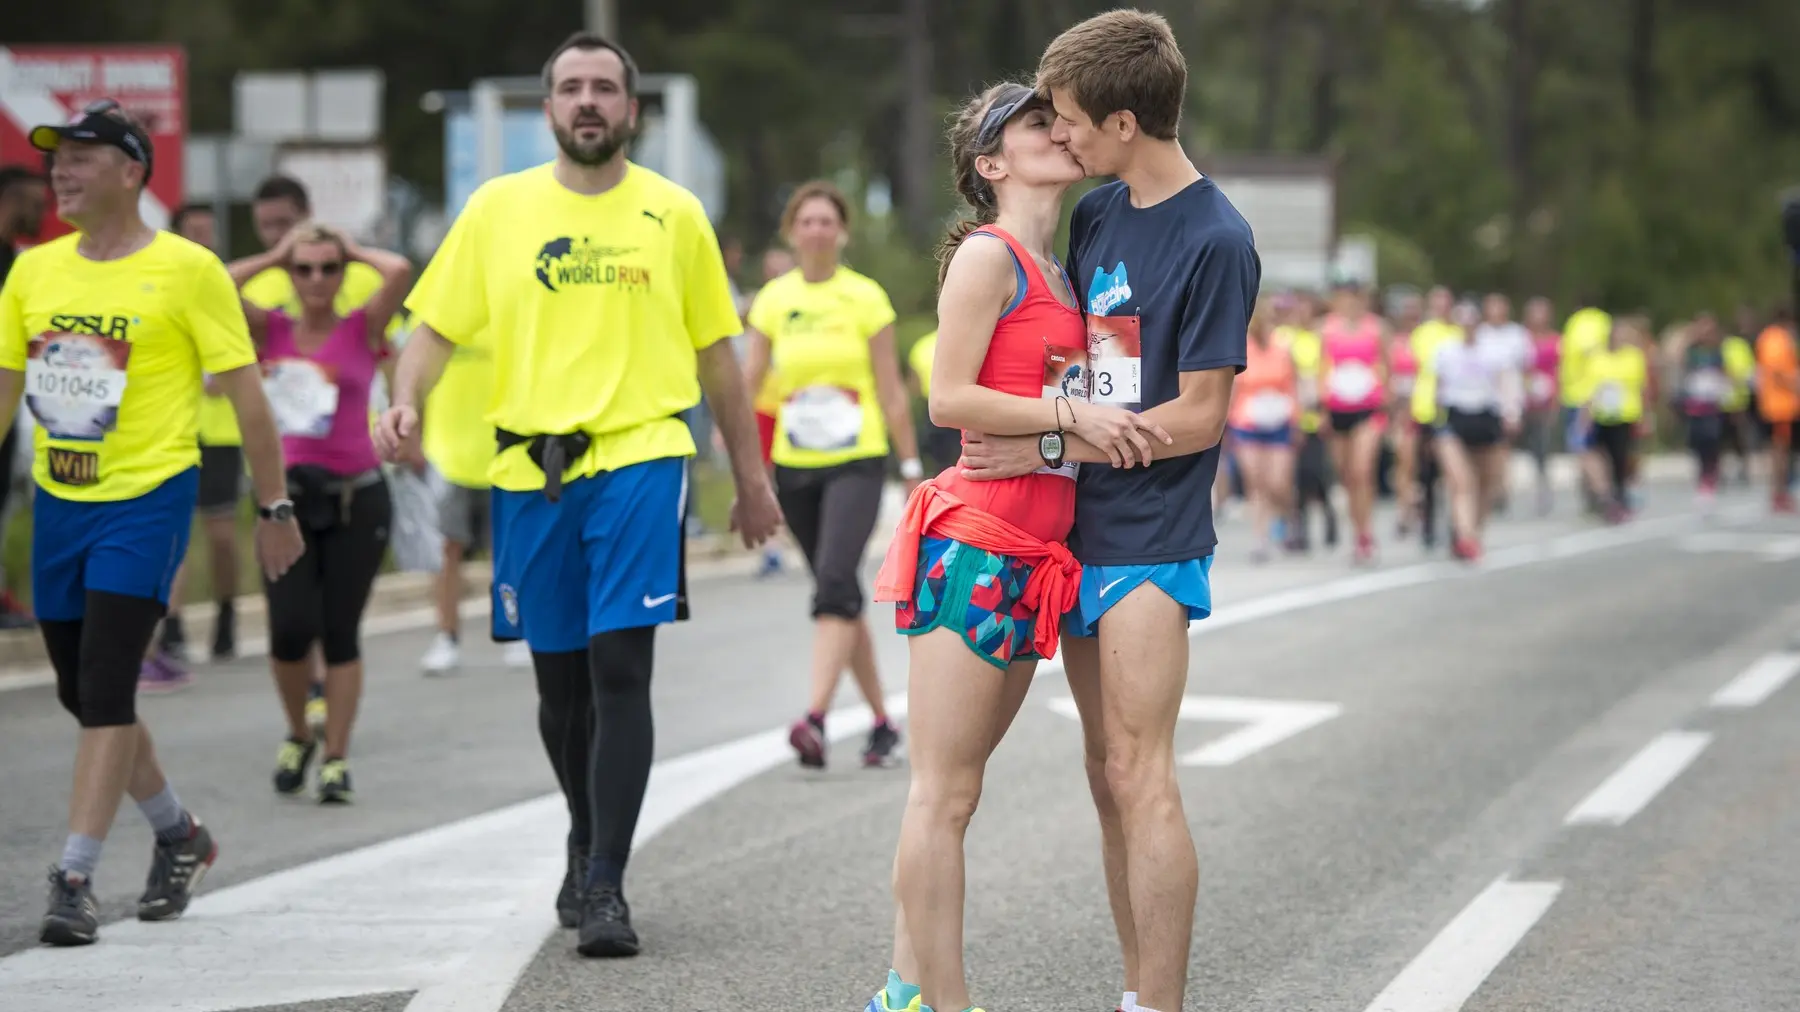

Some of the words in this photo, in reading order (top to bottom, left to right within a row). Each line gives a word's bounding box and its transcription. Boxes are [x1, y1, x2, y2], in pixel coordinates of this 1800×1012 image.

[556, 265, 615, 284] WORLD
[618, 266, 650, 285] RUN
[37, 372, 110, 400] 101045
[50, 448, 97, 480] Will
